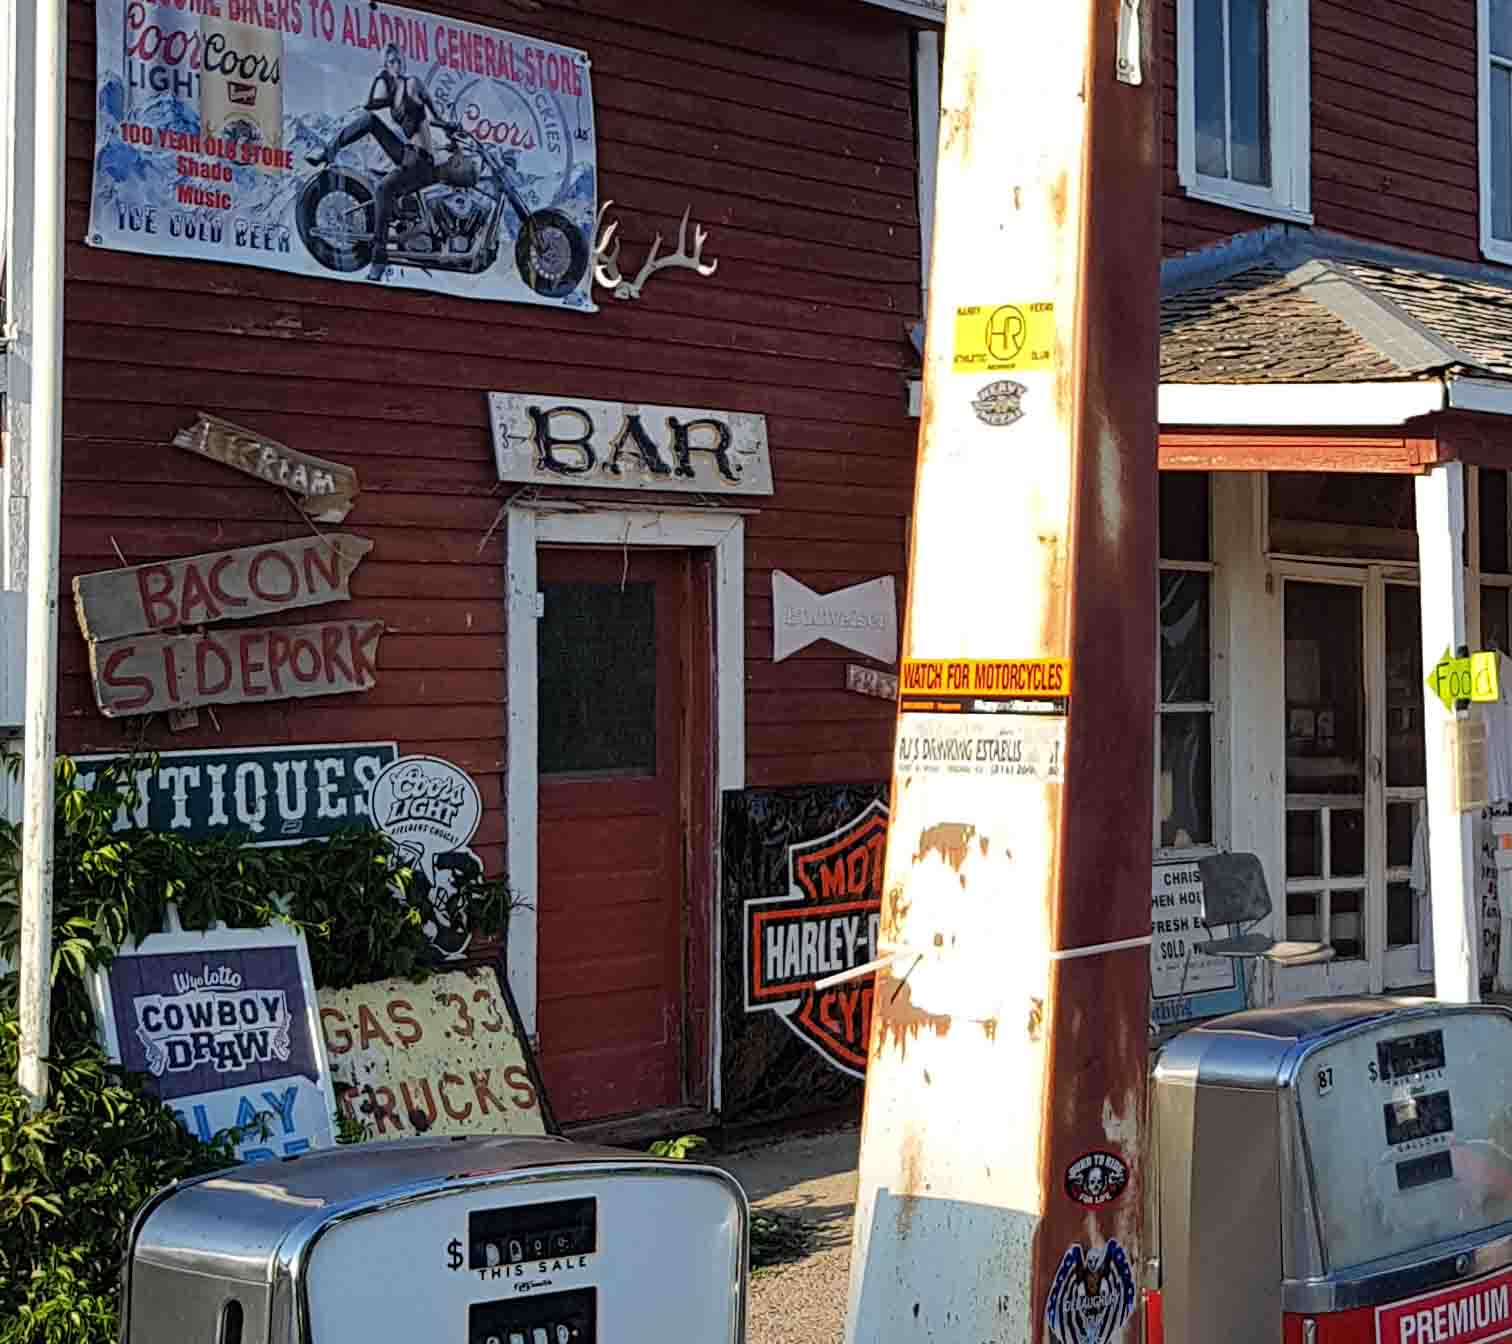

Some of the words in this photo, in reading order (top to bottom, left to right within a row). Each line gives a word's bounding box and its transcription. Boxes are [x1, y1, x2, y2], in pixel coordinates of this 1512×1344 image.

[204, 32, 280, 85] Coors
[343, 5, 428, 62] ALADDIN
[435, 25, 519, 83] GENERAL
[522, 45, 582, 96] STORE
[129, 59, 201, 99] LIGH
[121, 122, 152, 146] 100
[159, 126, 200, 153] YEAR
[206, 134, 239, 159] OLD
[241, 143, 294, 170] STORE
[464, 103, 537, 151] Coors
[176, 155, 233, 182] Shade
[116, 205, 157, 235] ICE
[169, 213, 223, 244] COLD
[235, 217, 291, 254] BEER
[528, 406, 741, 486] BAR
[136, 540, 341, 630] BACON
[903, 663, 942, 689] WATCH
[947, 663, 970, 689] FOR
[975, 663, 1064, 690] MOTORCYCLES
[1436, 661, 1493, 698] Food
[390, 763, 465, 807] Coors
[385, 796, 458, 828] LIGHT
[1160, 939, 1185, 959] SOLD
[141, 996, 280, 1032] COWBOY
[319, 1000, 423, 1054] GAS
[165, 1030, 270, 1069] DRAW
[1318, 1068, 1333, 1088] 87
[1368, 1061, 1377, 1083] $
[339, 1064, 537, 1134] TRUCKS
[447, 1237, 464, 1272] $
[479, 1264, 524, 1281] THIS
[538, 1256, 588, 1273] SALE
